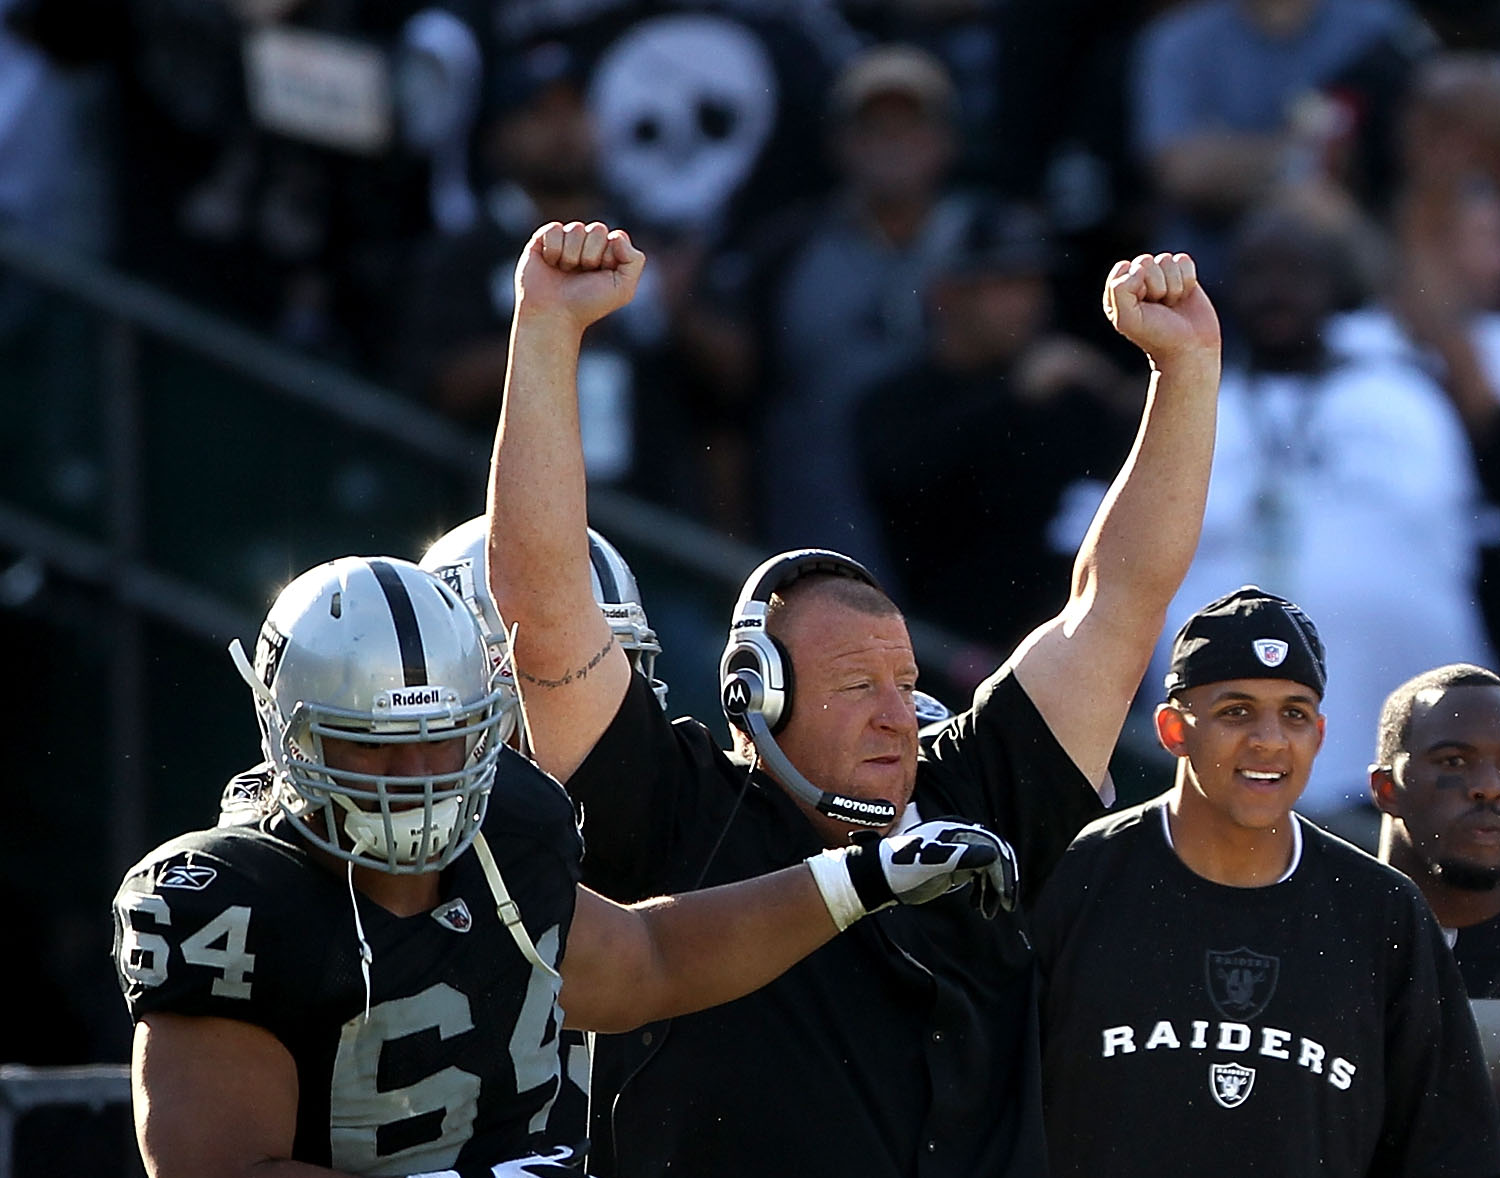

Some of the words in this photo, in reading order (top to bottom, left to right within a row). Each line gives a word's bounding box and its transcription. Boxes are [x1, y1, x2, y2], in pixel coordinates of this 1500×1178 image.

[392, 691, 440, 707] Riddell
[832, 796, 895, 816] MOTOROLA
[112, 890, 256, 1000] 64
[330, 923, 593, 1178] 64
[1102, 1020, 1356, 1090] RAIDERS
